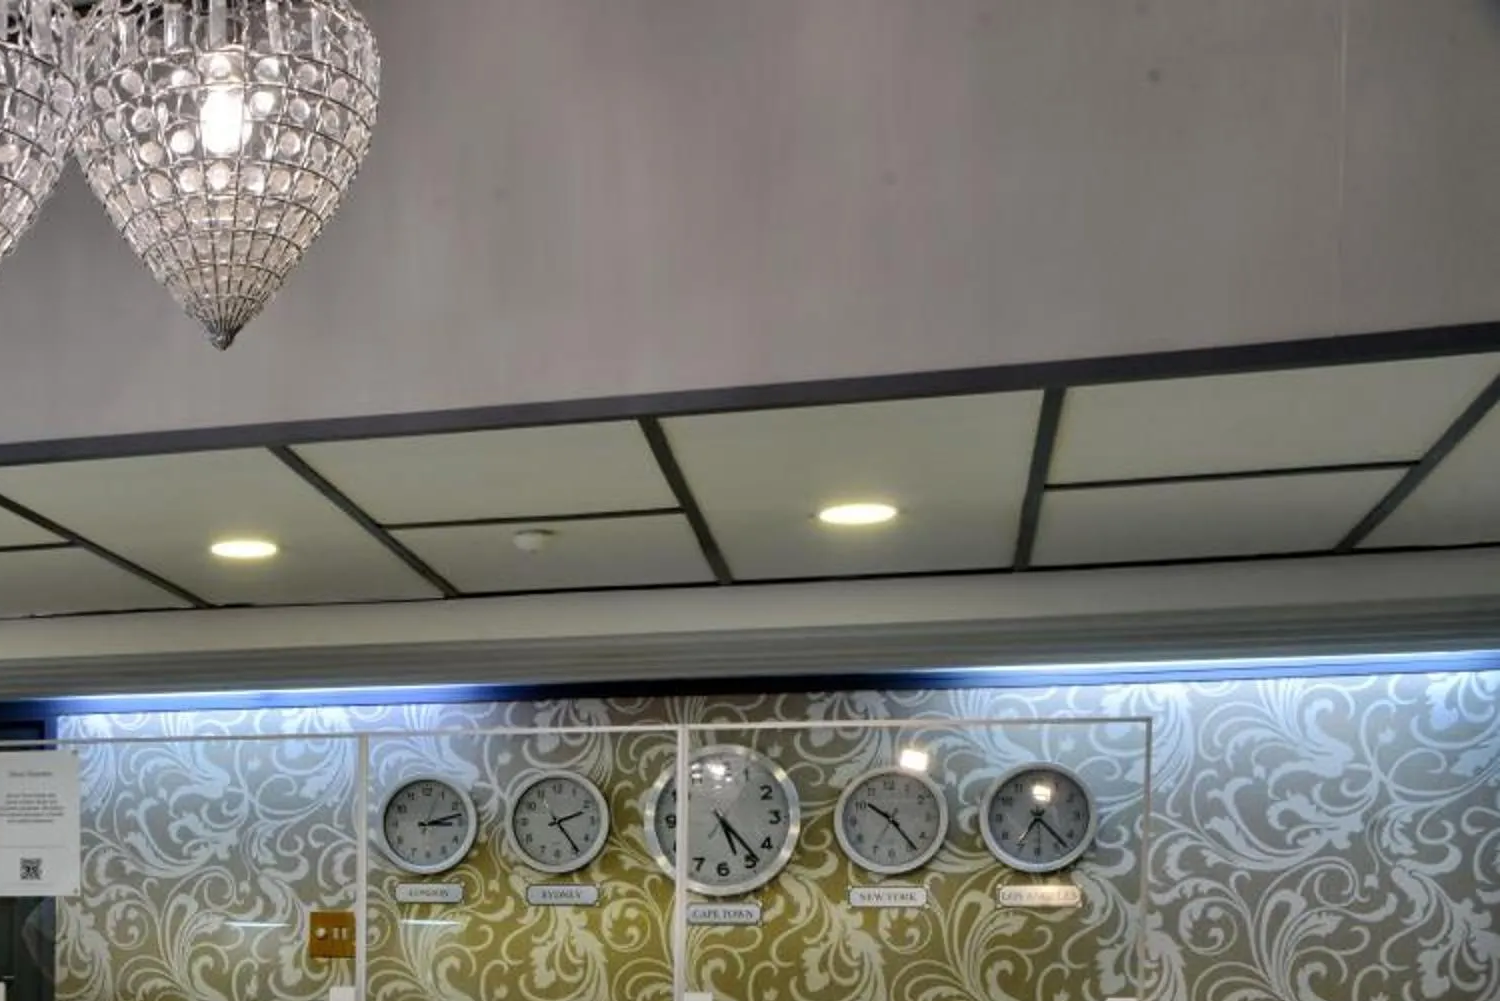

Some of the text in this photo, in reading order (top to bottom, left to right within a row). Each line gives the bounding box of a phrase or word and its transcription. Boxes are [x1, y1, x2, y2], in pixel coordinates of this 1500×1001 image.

[760, 785, 773, 800] 2
[769, 810, 781, 825] 3
[761, 836, 773, 849] 4
[692, 857, 706, 871] 7
[717, 862, 730, 877] 6
[541, 889, 582, 899] SYDNEY
[859, 891, 916, 902] NEW YORK
[692, 908, 754, 919] CAPE TOWN
